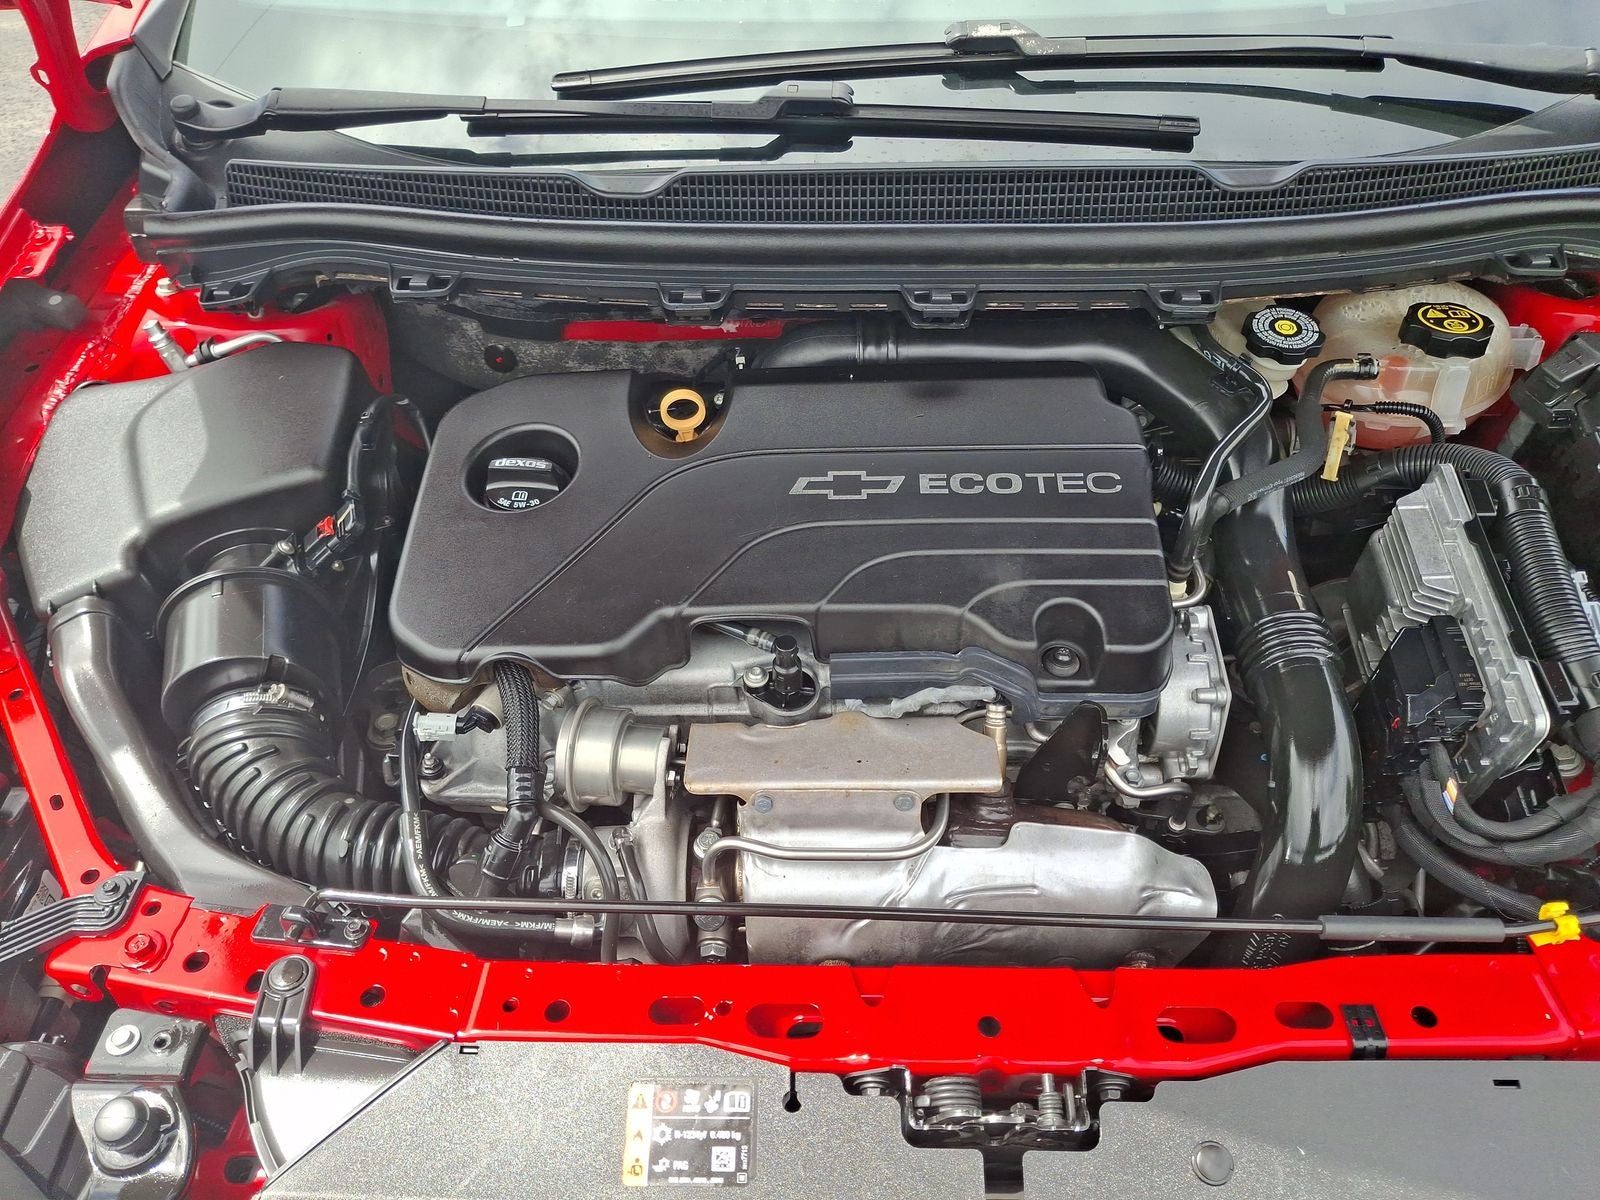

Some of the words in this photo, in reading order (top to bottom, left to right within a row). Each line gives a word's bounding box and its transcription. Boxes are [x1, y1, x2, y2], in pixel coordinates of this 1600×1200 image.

[495, 458, 546, 469] dexos
[918, 471, 1123, 494] ECOTEC
[497, 497, 512, 506] SAE
[513, 499, 540, 508] 5W-30
